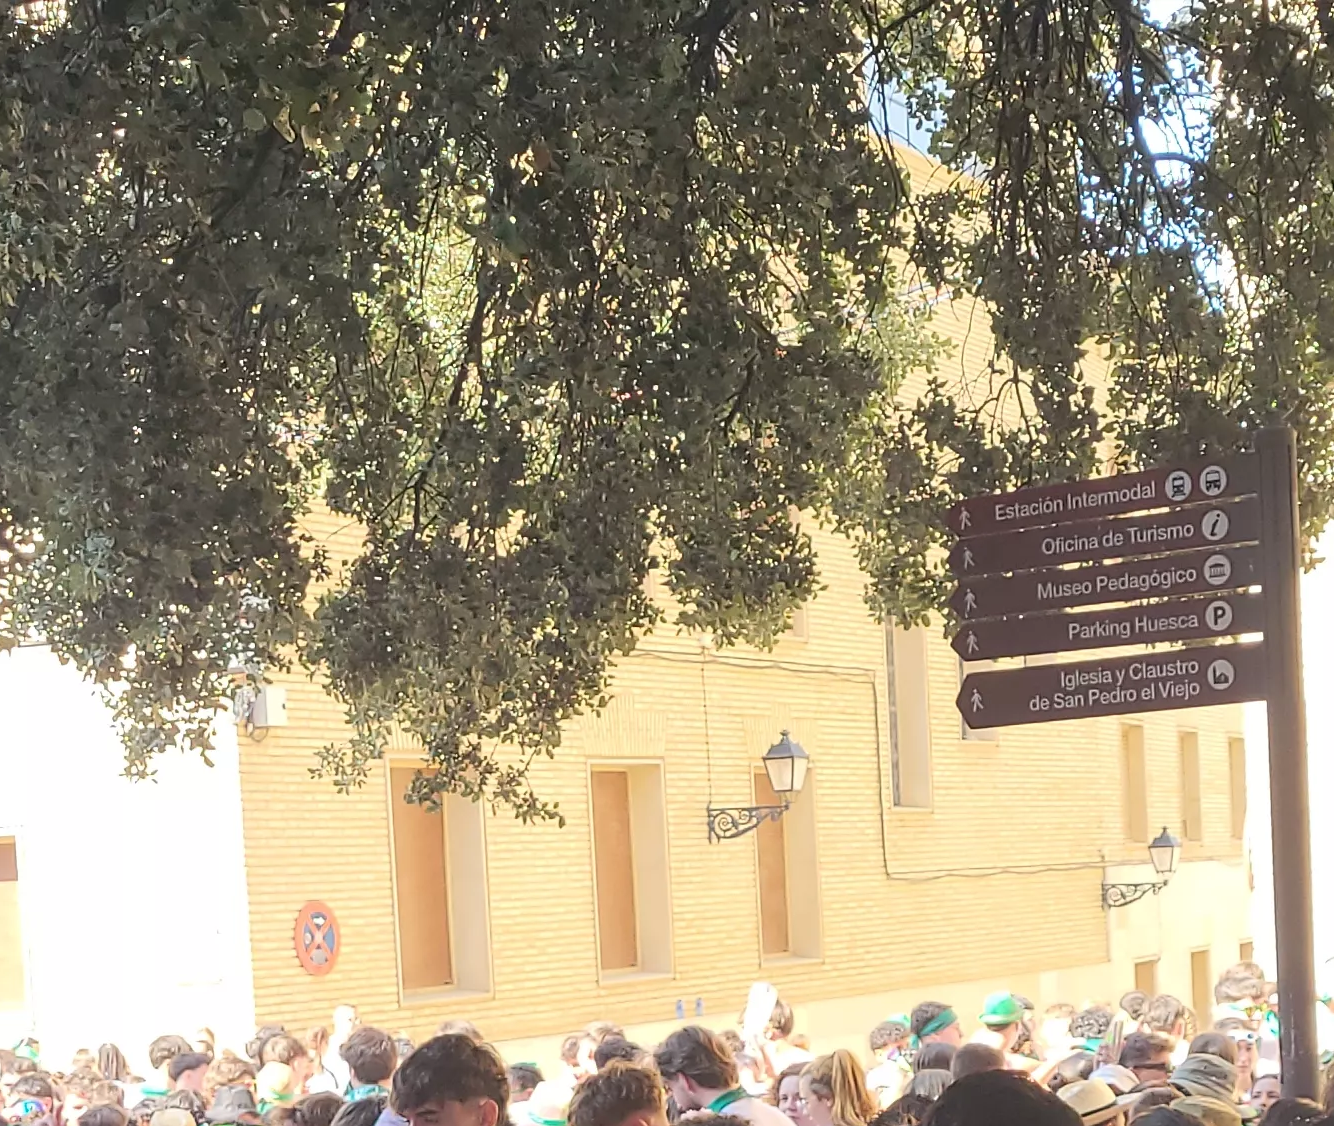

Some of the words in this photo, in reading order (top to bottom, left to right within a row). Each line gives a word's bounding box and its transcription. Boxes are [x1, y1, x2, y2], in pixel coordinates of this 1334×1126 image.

[995, 496, 1064, 521] Estación
[1067, 480, 1156, 510] Intermodal
[1041, 534, 1099, 555] Oficina
[1102, 530, 1124, 547] de
[1127, 523, 1195, 545] Turismo
[1037, 580, 1092, 600] Museo
[1096, 567, 1197, 593] Pedagógico
[1069, 619, 1131, 641] Parking
[1135, 614, 1199, 634] Huesca
[1060, 666, 1113, 691] Iglesia
[1116, 668, 1126, 686] y
[1129, 660, 1199, 680] Claustro
[1029, 694, 1050, 711] de
[1053, 692, 1085, 709] San
[1088, 686, 1137, 706] Pedro
[1141, 681, 1155, 700] el
[1158, 679, 1201, 700] Viejo
